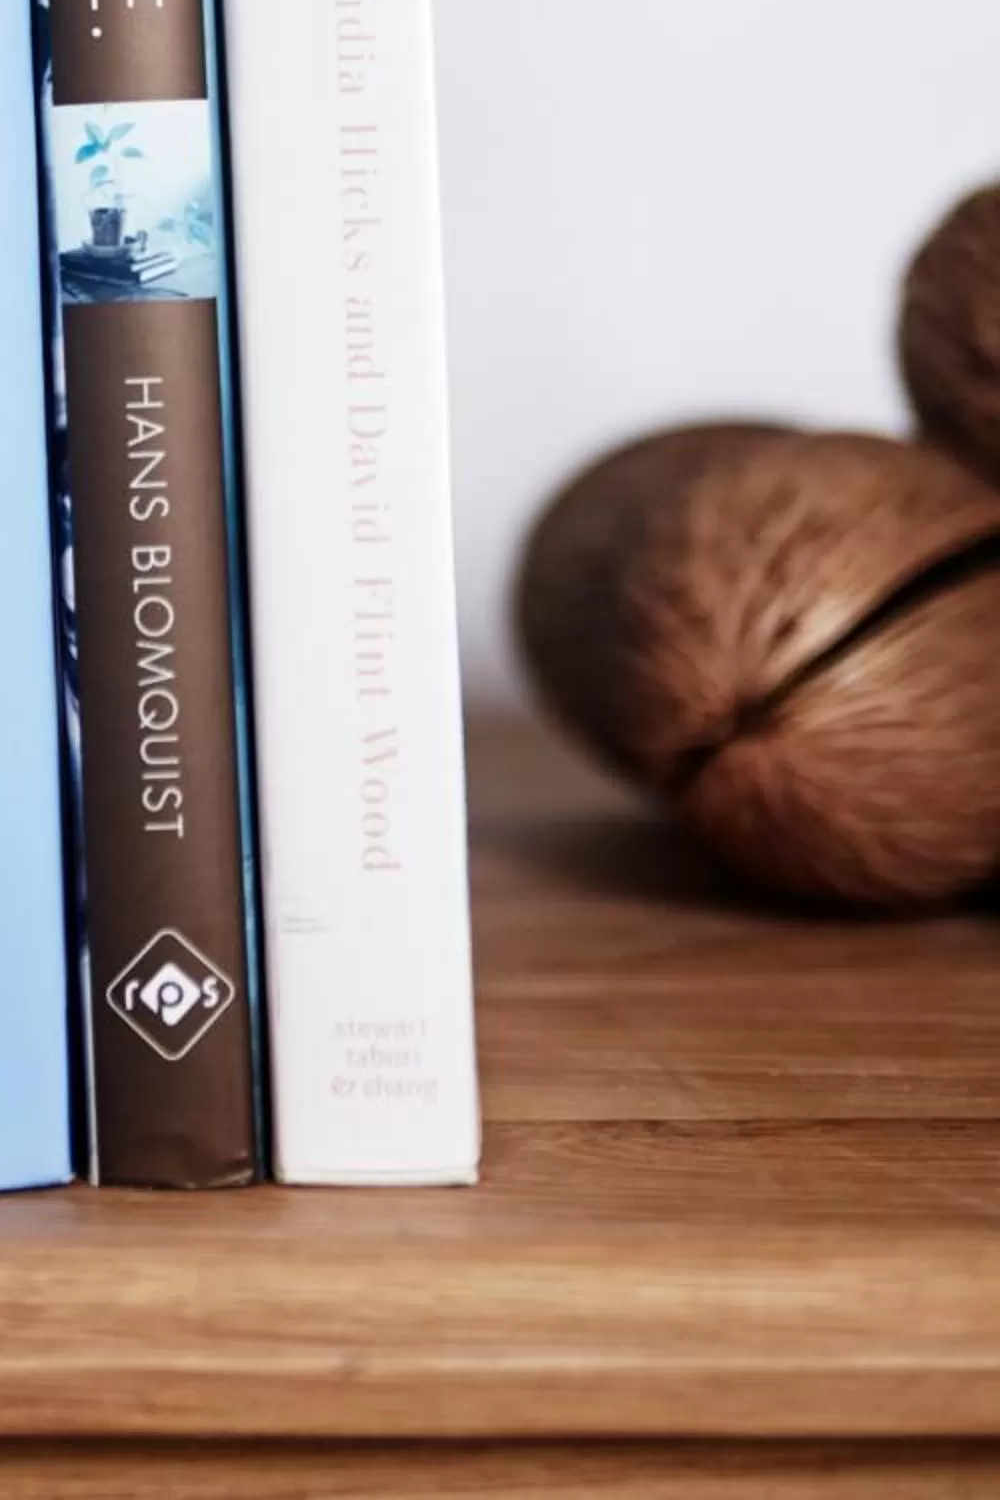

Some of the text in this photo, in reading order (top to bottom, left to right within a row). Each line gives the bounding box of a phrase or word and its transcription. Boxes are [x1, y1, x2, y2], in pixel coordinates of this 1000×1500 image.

[340, 124, 382, 273] Hicks
[345, 295, 387, 382] and
[348, 404, 392, 547] David
[124, 376, 185, 838] HANS BLOMQUIST
[354, 576, 395, 700] Flint
[360, 723, 402, 874] Wood
